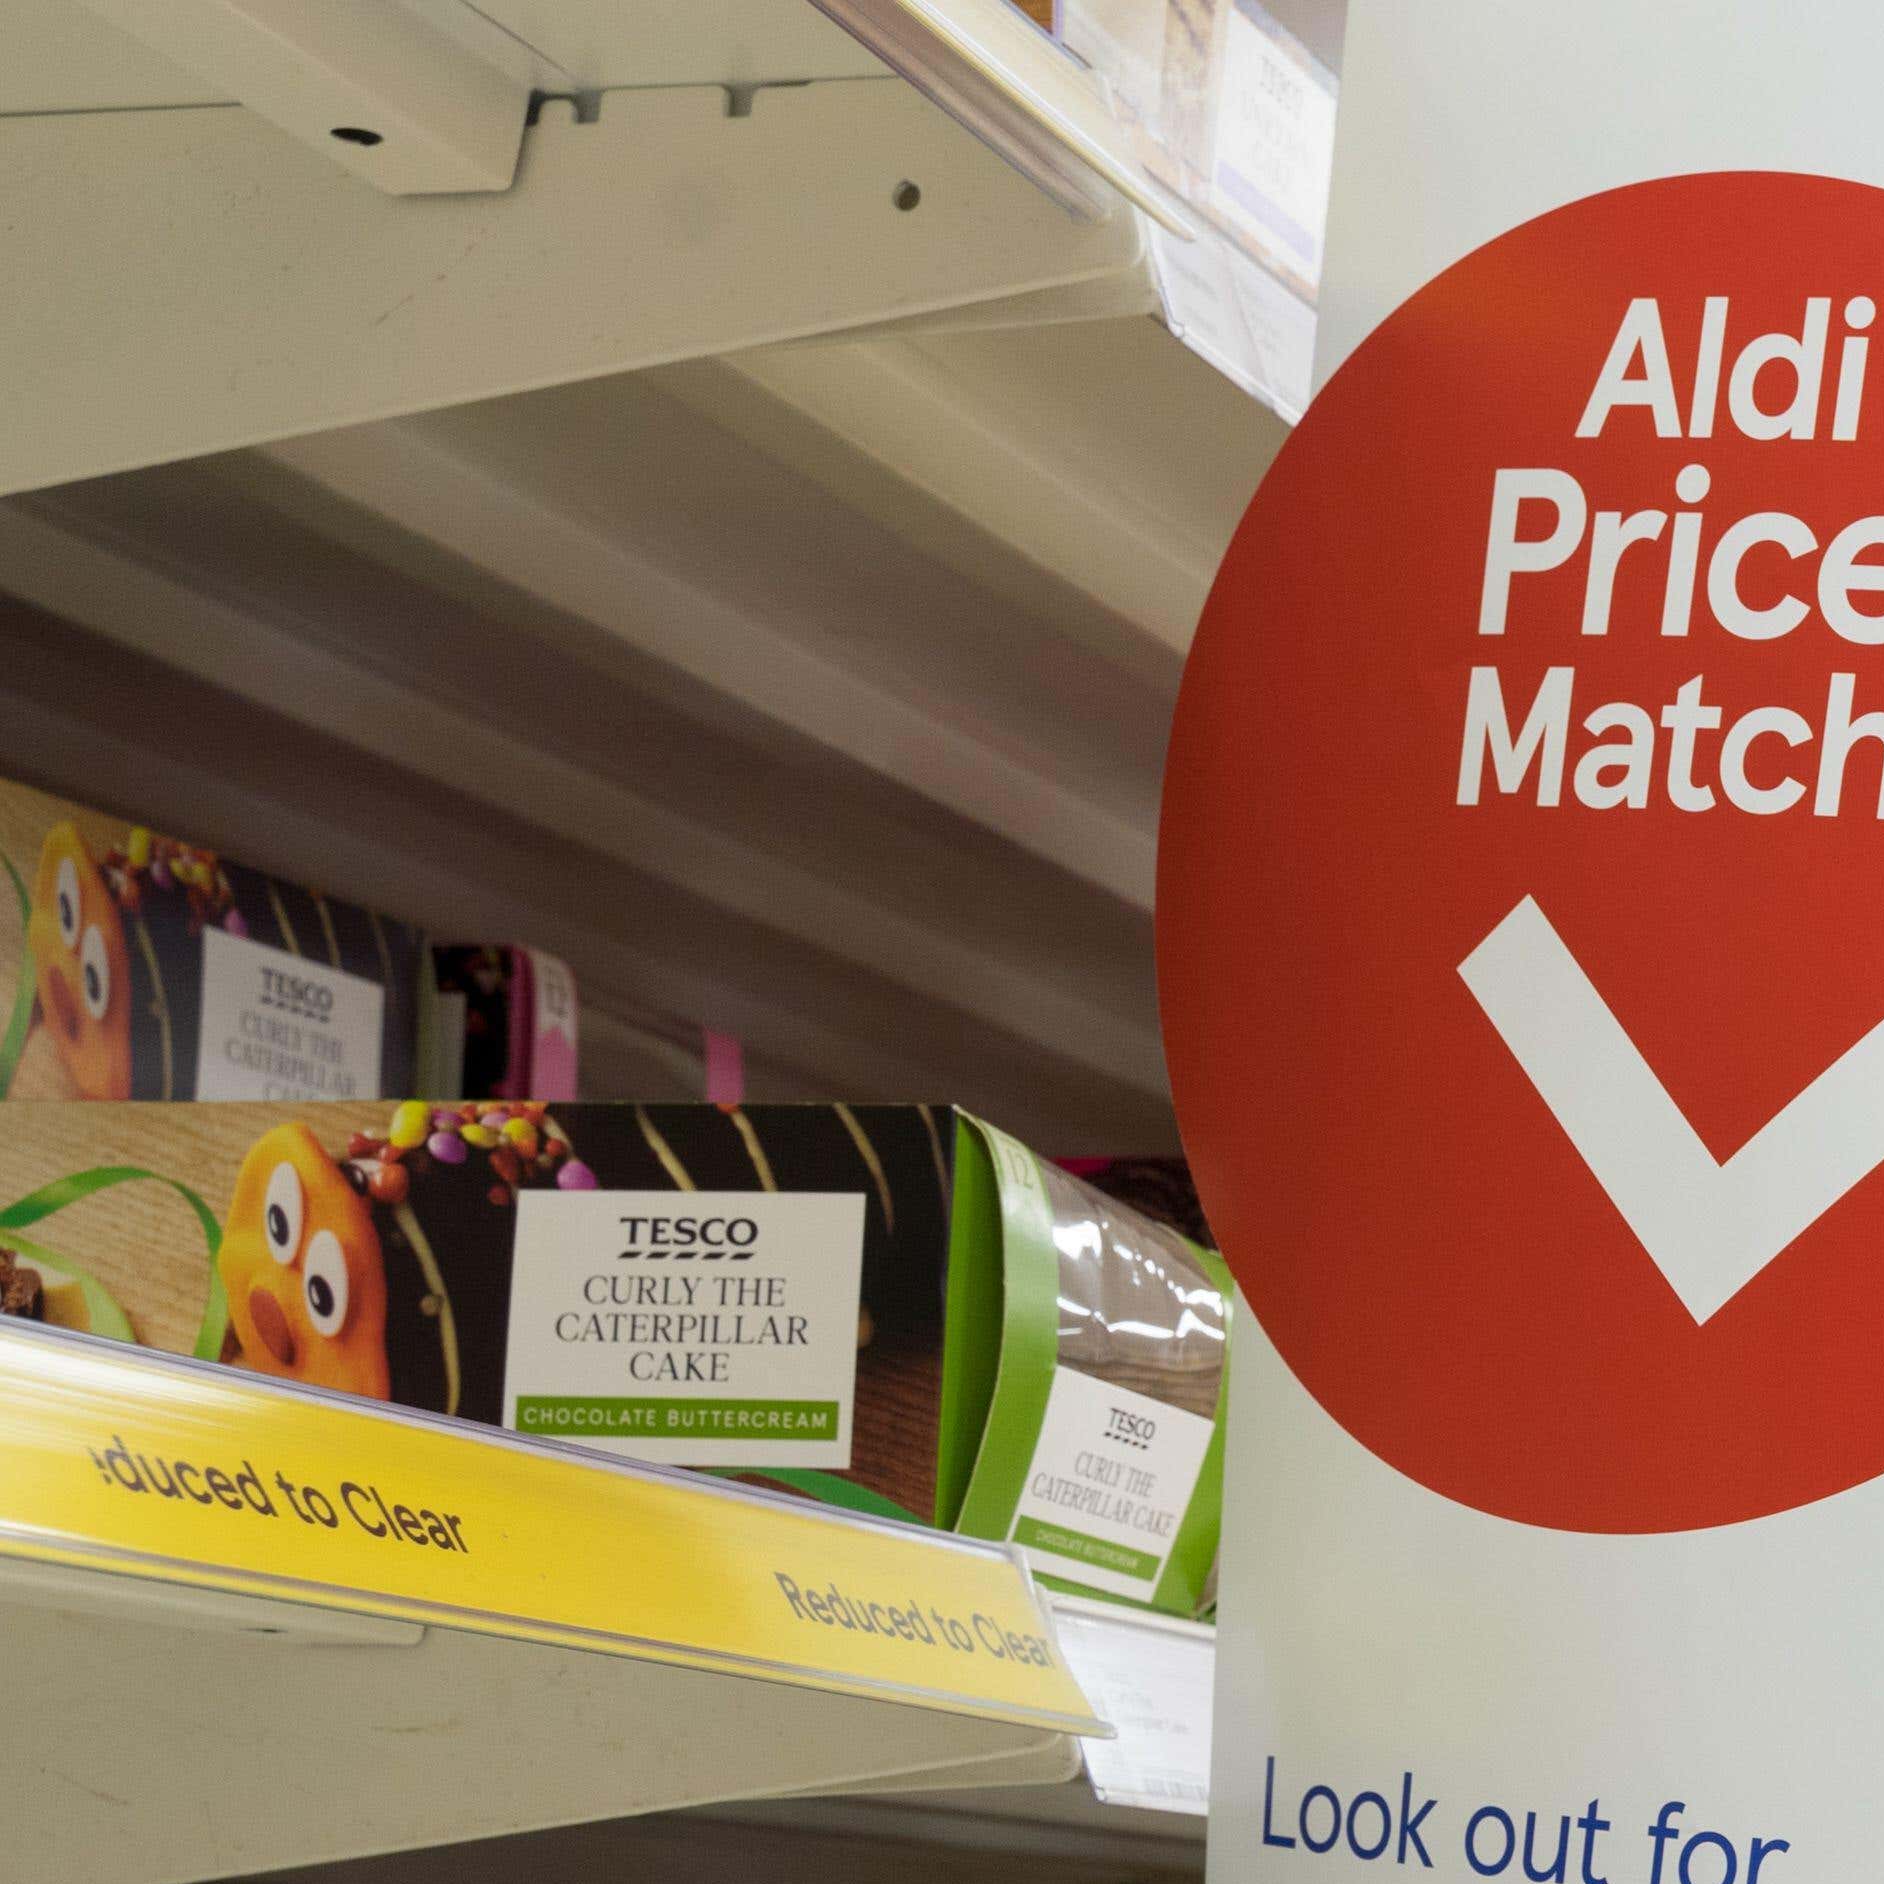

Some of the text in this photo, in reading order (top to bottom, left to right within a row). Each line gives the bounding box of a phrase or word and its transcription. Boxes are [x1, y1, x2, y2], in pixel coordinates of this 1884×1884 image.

[1574, 295, 1876, 441] Aldi
[261, 967, 334, 1012] TESCO
[620, 1217, 759, 1246] TESCO
[583, 1275, 787, 1308] CURLY THE
[554, 1312, 809, 1346] CATERPILLAR
[629, 1351, 730, 1382] CAKE
[523, 1406, 828, 1430] CHOCOLATE BUTTERCREAM
[1110, 1407, 1157, 1441] TESCO
[87, 1435, 469, 1554] duced to Clear
[1075, 1451, 1156, 1498] CURLY THE
[1031, 1472, 1175, 1537] CATERPILLAR CAKE
[774, 1571, 1055, 1668] Reduced to Clear
[1262, 1755, 1438, 1869] Look
